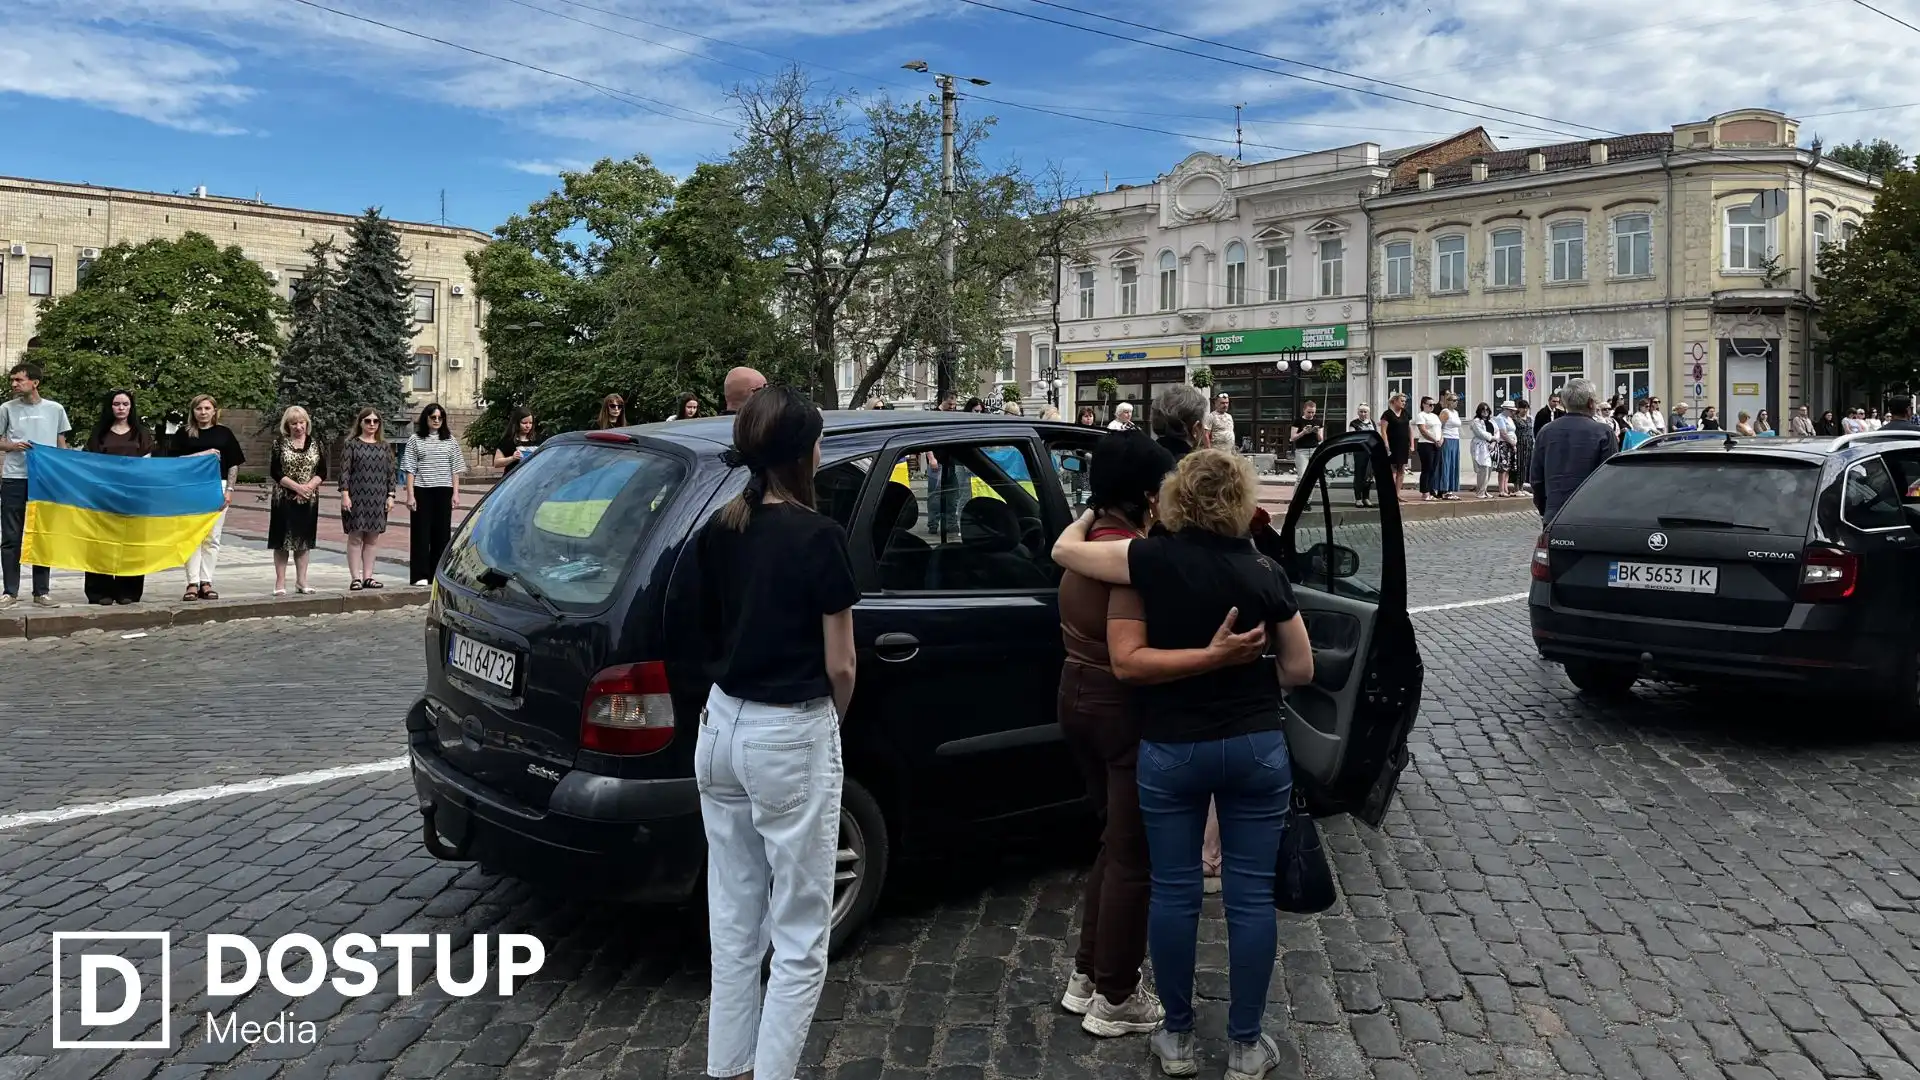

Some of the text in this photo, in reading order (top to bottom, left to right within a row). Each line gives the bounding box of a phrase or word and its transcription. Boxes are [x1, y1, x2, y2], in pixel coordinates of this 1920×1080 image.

[1215, 335, 1244, 344] master
[1632, 386, 1649, 398] SAL
[1747, 550, 1796, 560] OCTAVIA
[1619, 565, 1712, 586] BK 5653 IK
